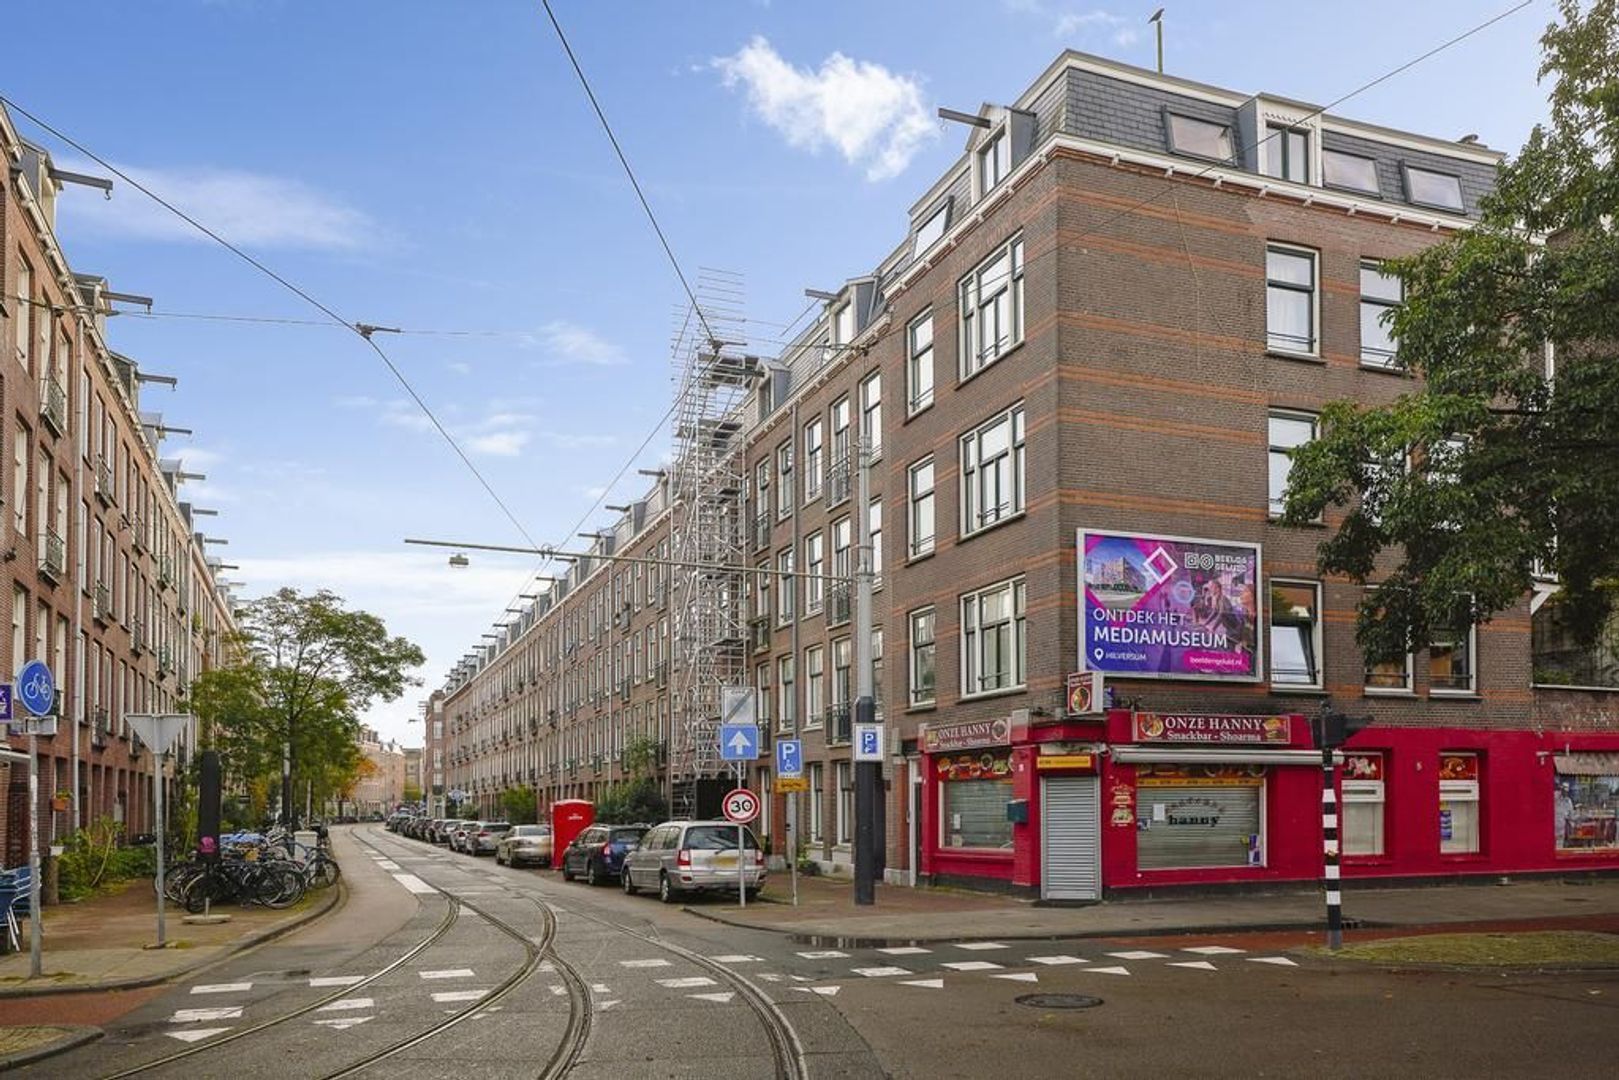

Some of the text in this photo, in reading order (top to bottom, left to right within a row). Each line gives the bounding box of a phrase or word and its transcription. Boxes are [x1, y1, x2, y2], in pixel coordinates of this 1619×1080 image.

[1093, 607, 1187, 626] ONTDEK HET
[1094, 626, 1228, 648] MEDIAMUSEUM
[1105, 652, 1147, 661] HILVERSUM
[960, 723, 992, 737] HANNY
[1165, 716, 1264, 731] ONZE HANNY
[865, 733, 874, 745] P
[1167, 731, 1212, 741] Snackbar
[1220, 731, 1262, 742] Shoarma
[782, 743, 796, 760] P
[731, 800, 753, 813] 30
[1168, 815, 1220, 827] hanny
